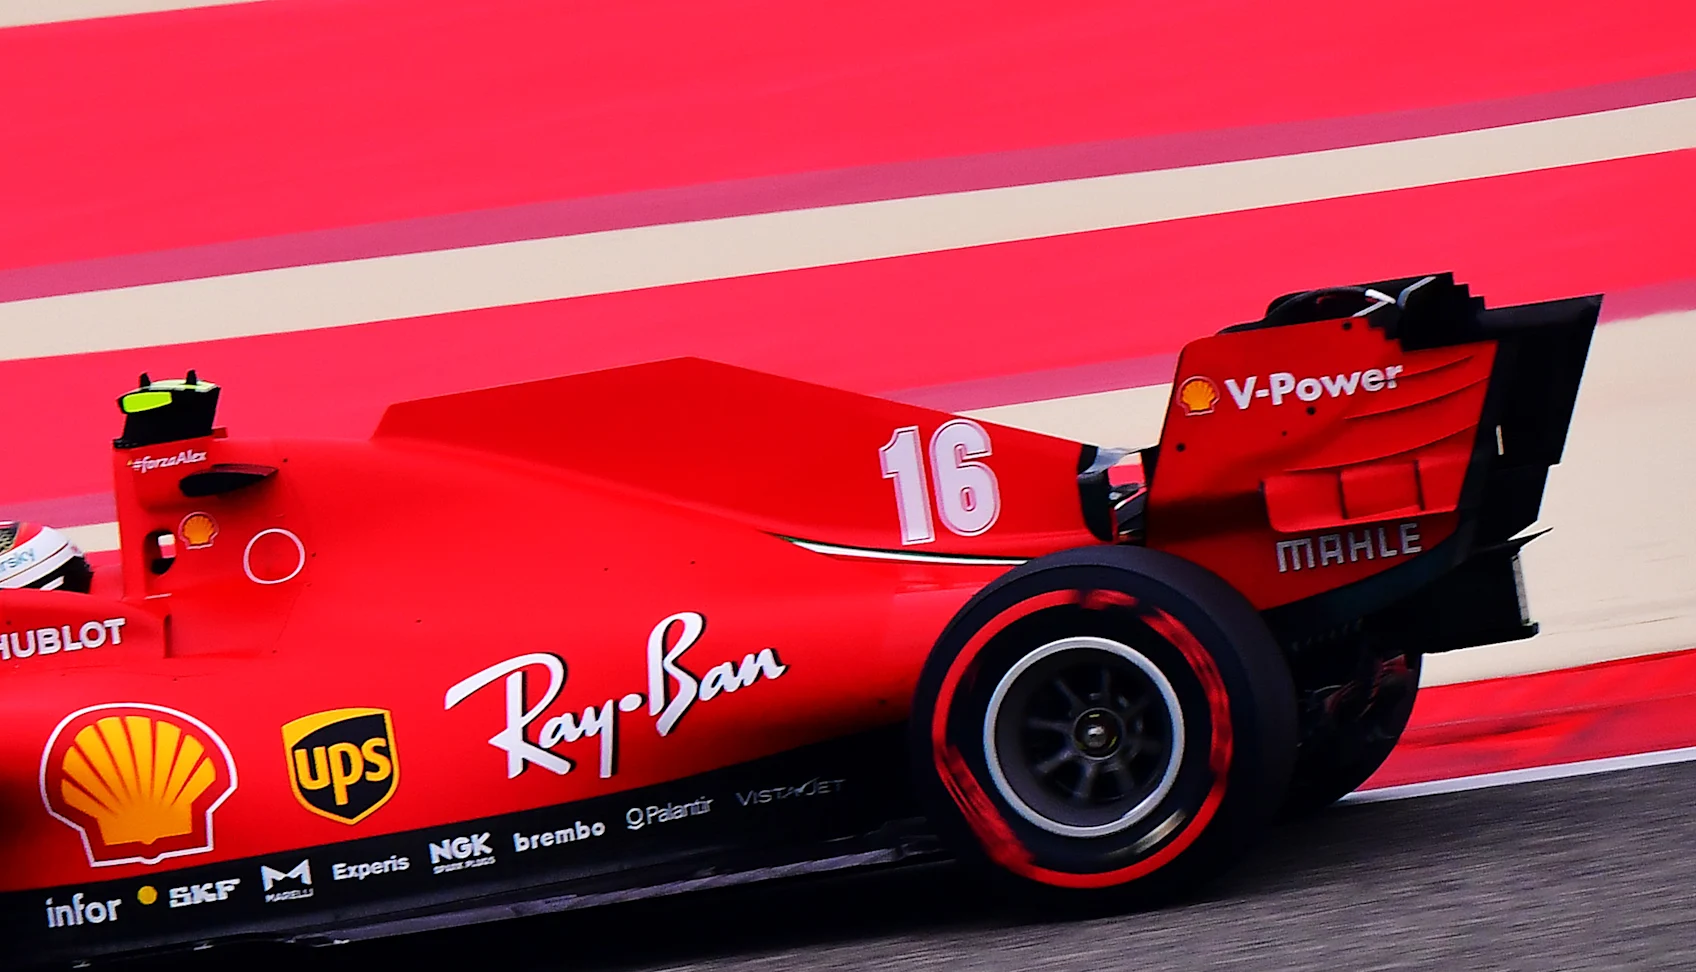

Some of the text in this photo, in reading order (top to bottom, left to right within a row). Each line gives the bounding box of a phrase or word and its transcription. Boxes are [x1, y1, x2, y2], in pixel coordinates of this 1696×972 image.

[1225, 364, 1403, 410] V-Power
[878, 418, 1002, 546] 16
[1276, 523, 1423, 573] MAHLE
[294, 737, 392, 806] ups
[645, 796, 714, 825] Palantir
[428, 831, 493, 864] NGK
[513, 821, 606, 853] brembo
[332, 855, 410, 881] Experis
[45, 892, 122, 928] infor
[168, 879, 241, 909] SKF
